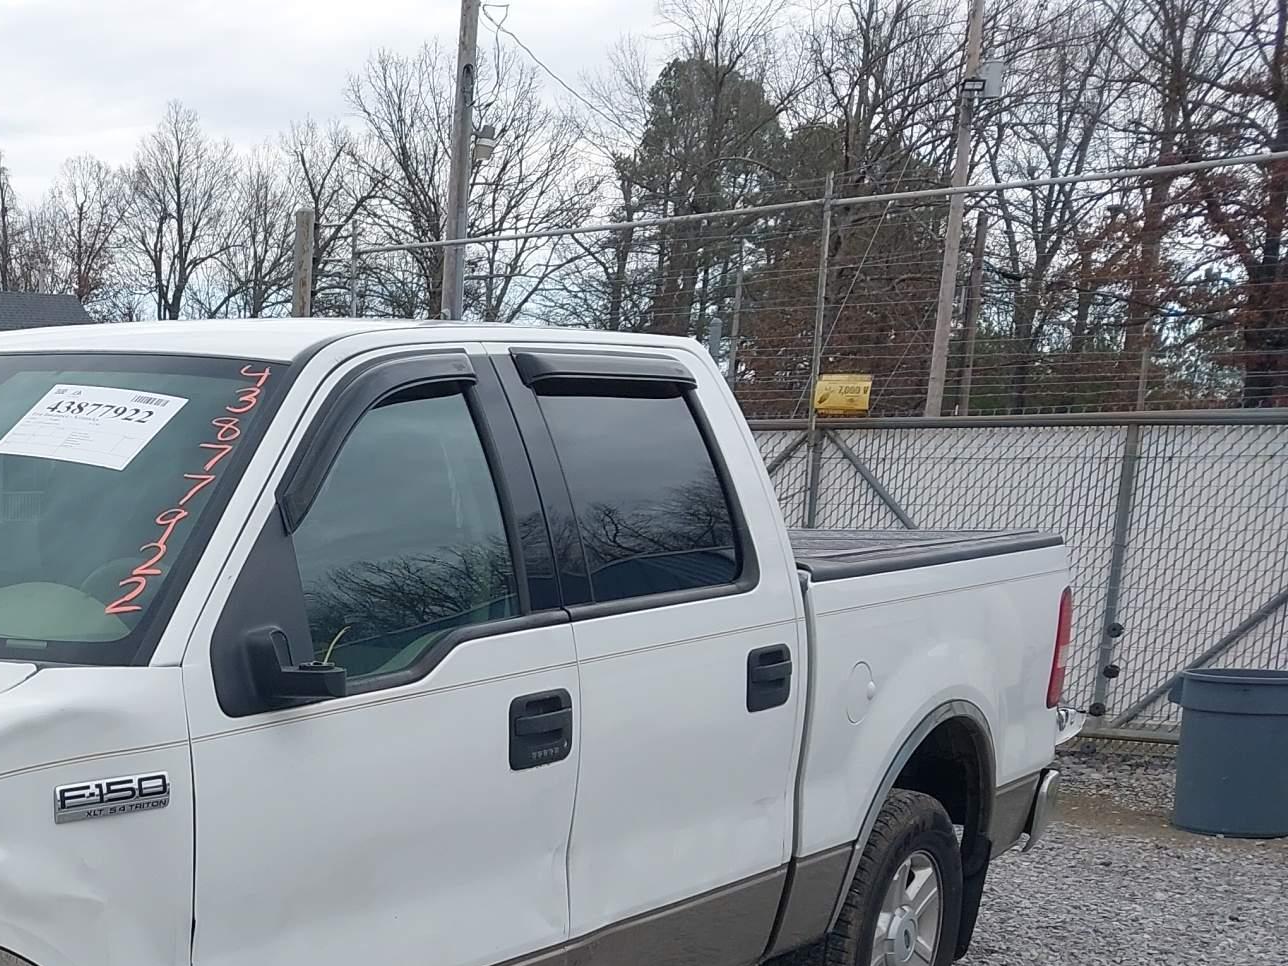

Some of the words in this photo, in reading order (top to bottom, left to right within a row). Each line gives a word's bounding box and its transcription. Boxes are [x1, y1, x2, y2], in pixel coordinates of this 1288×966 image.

[47, 400, 153, 423] 43877922
[105, 364, 271, 614] 43877922
[86, 808, 104, 817] XLT
[129, 799, 167, 811] TRITON
